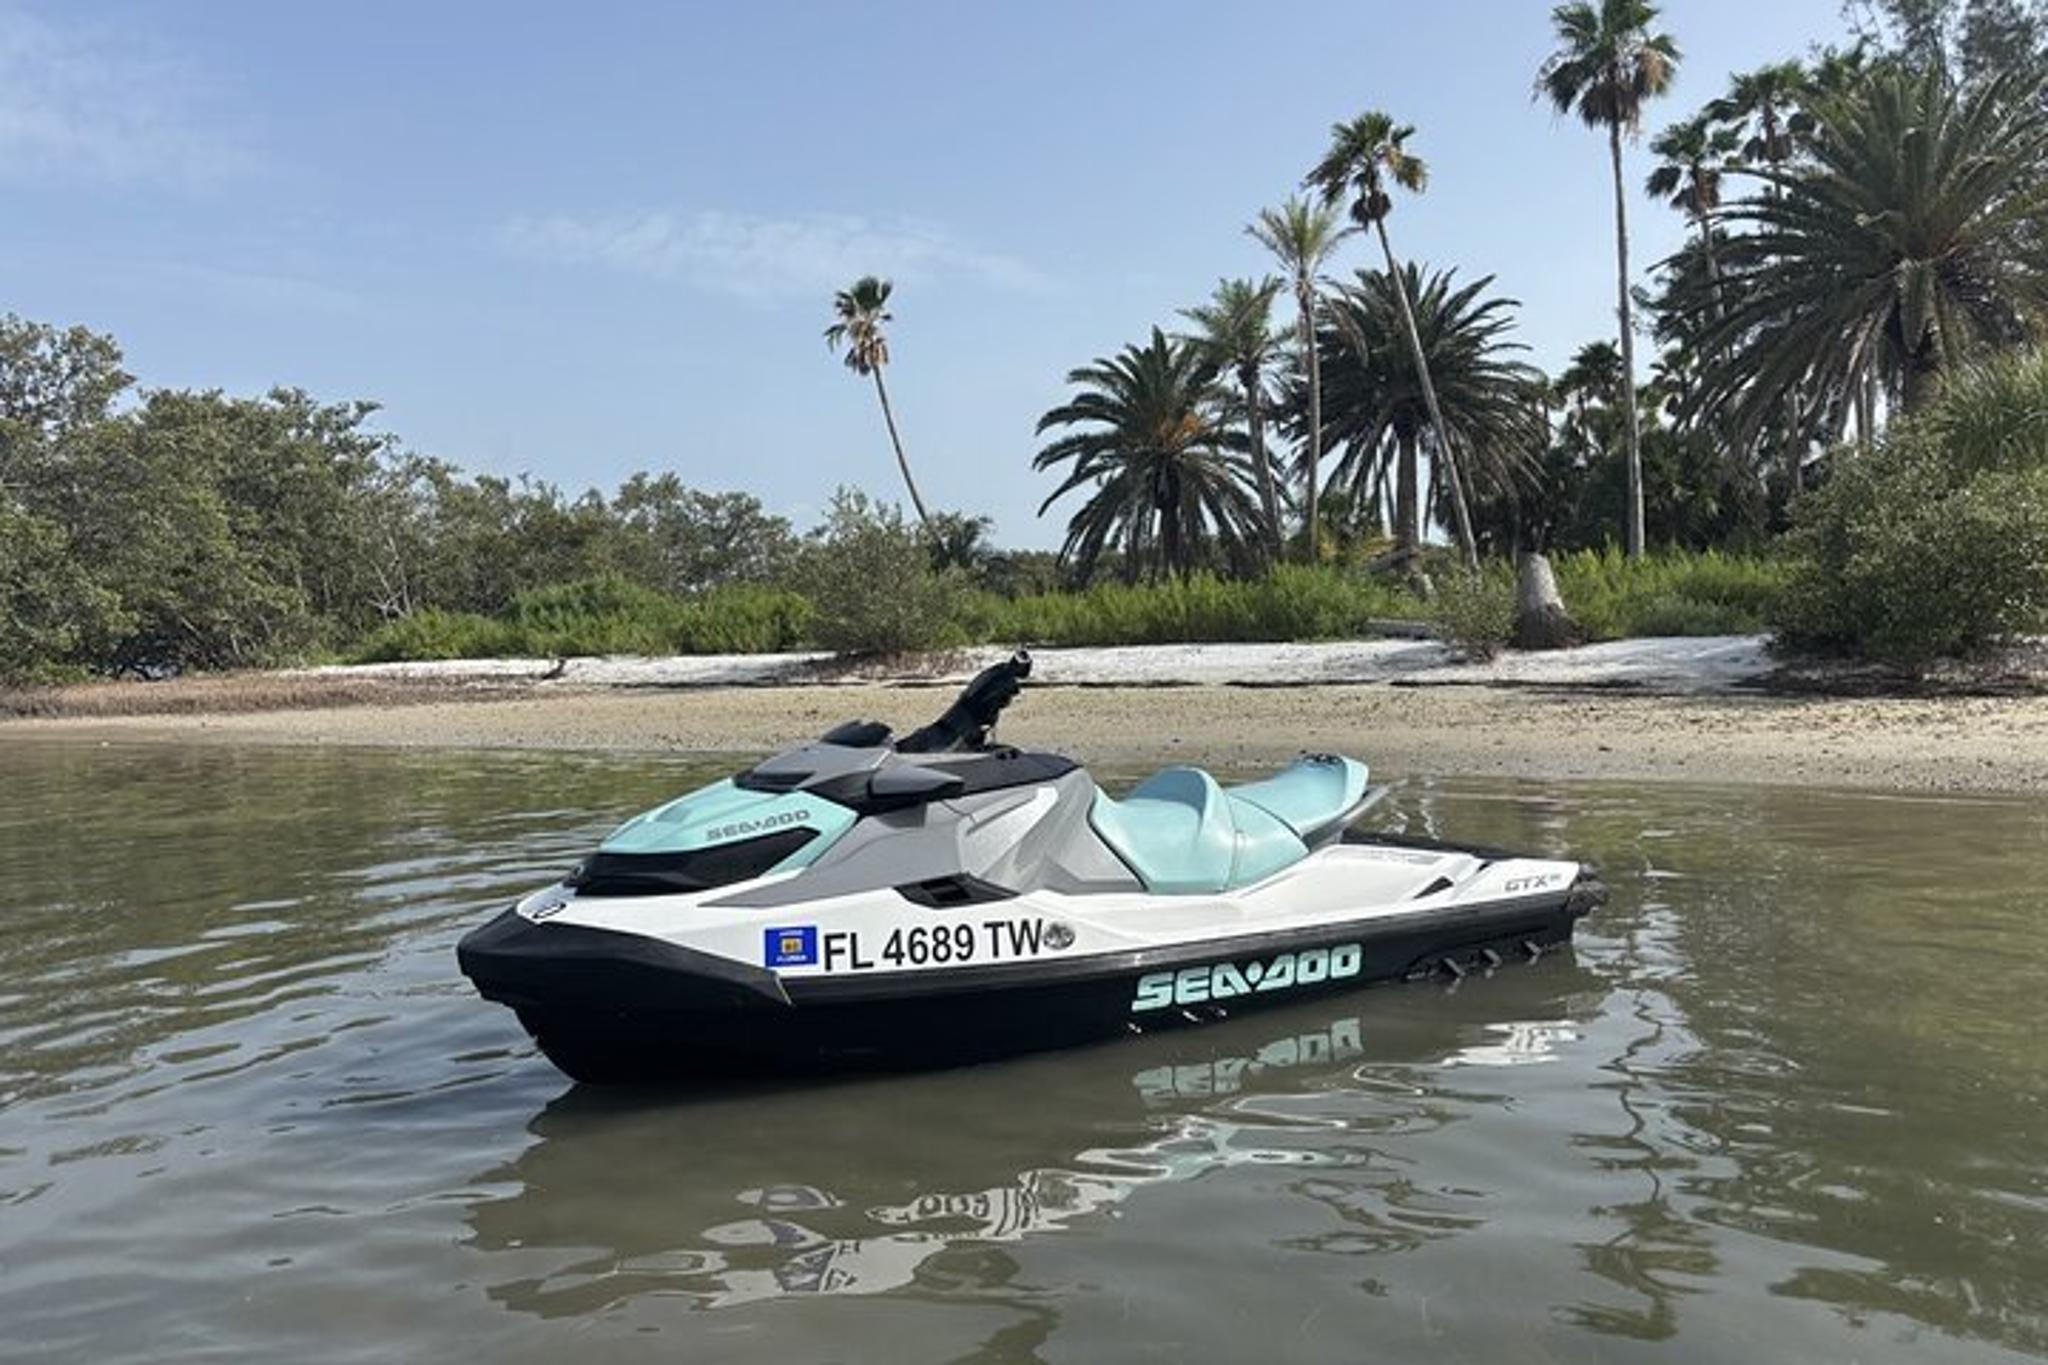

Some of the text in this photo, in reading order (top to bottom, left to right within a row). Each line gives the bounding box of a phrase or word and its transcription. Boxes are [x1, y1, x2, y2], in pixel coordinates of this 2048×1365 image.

[823, 918, 1044, 971] FL 4689 TW
